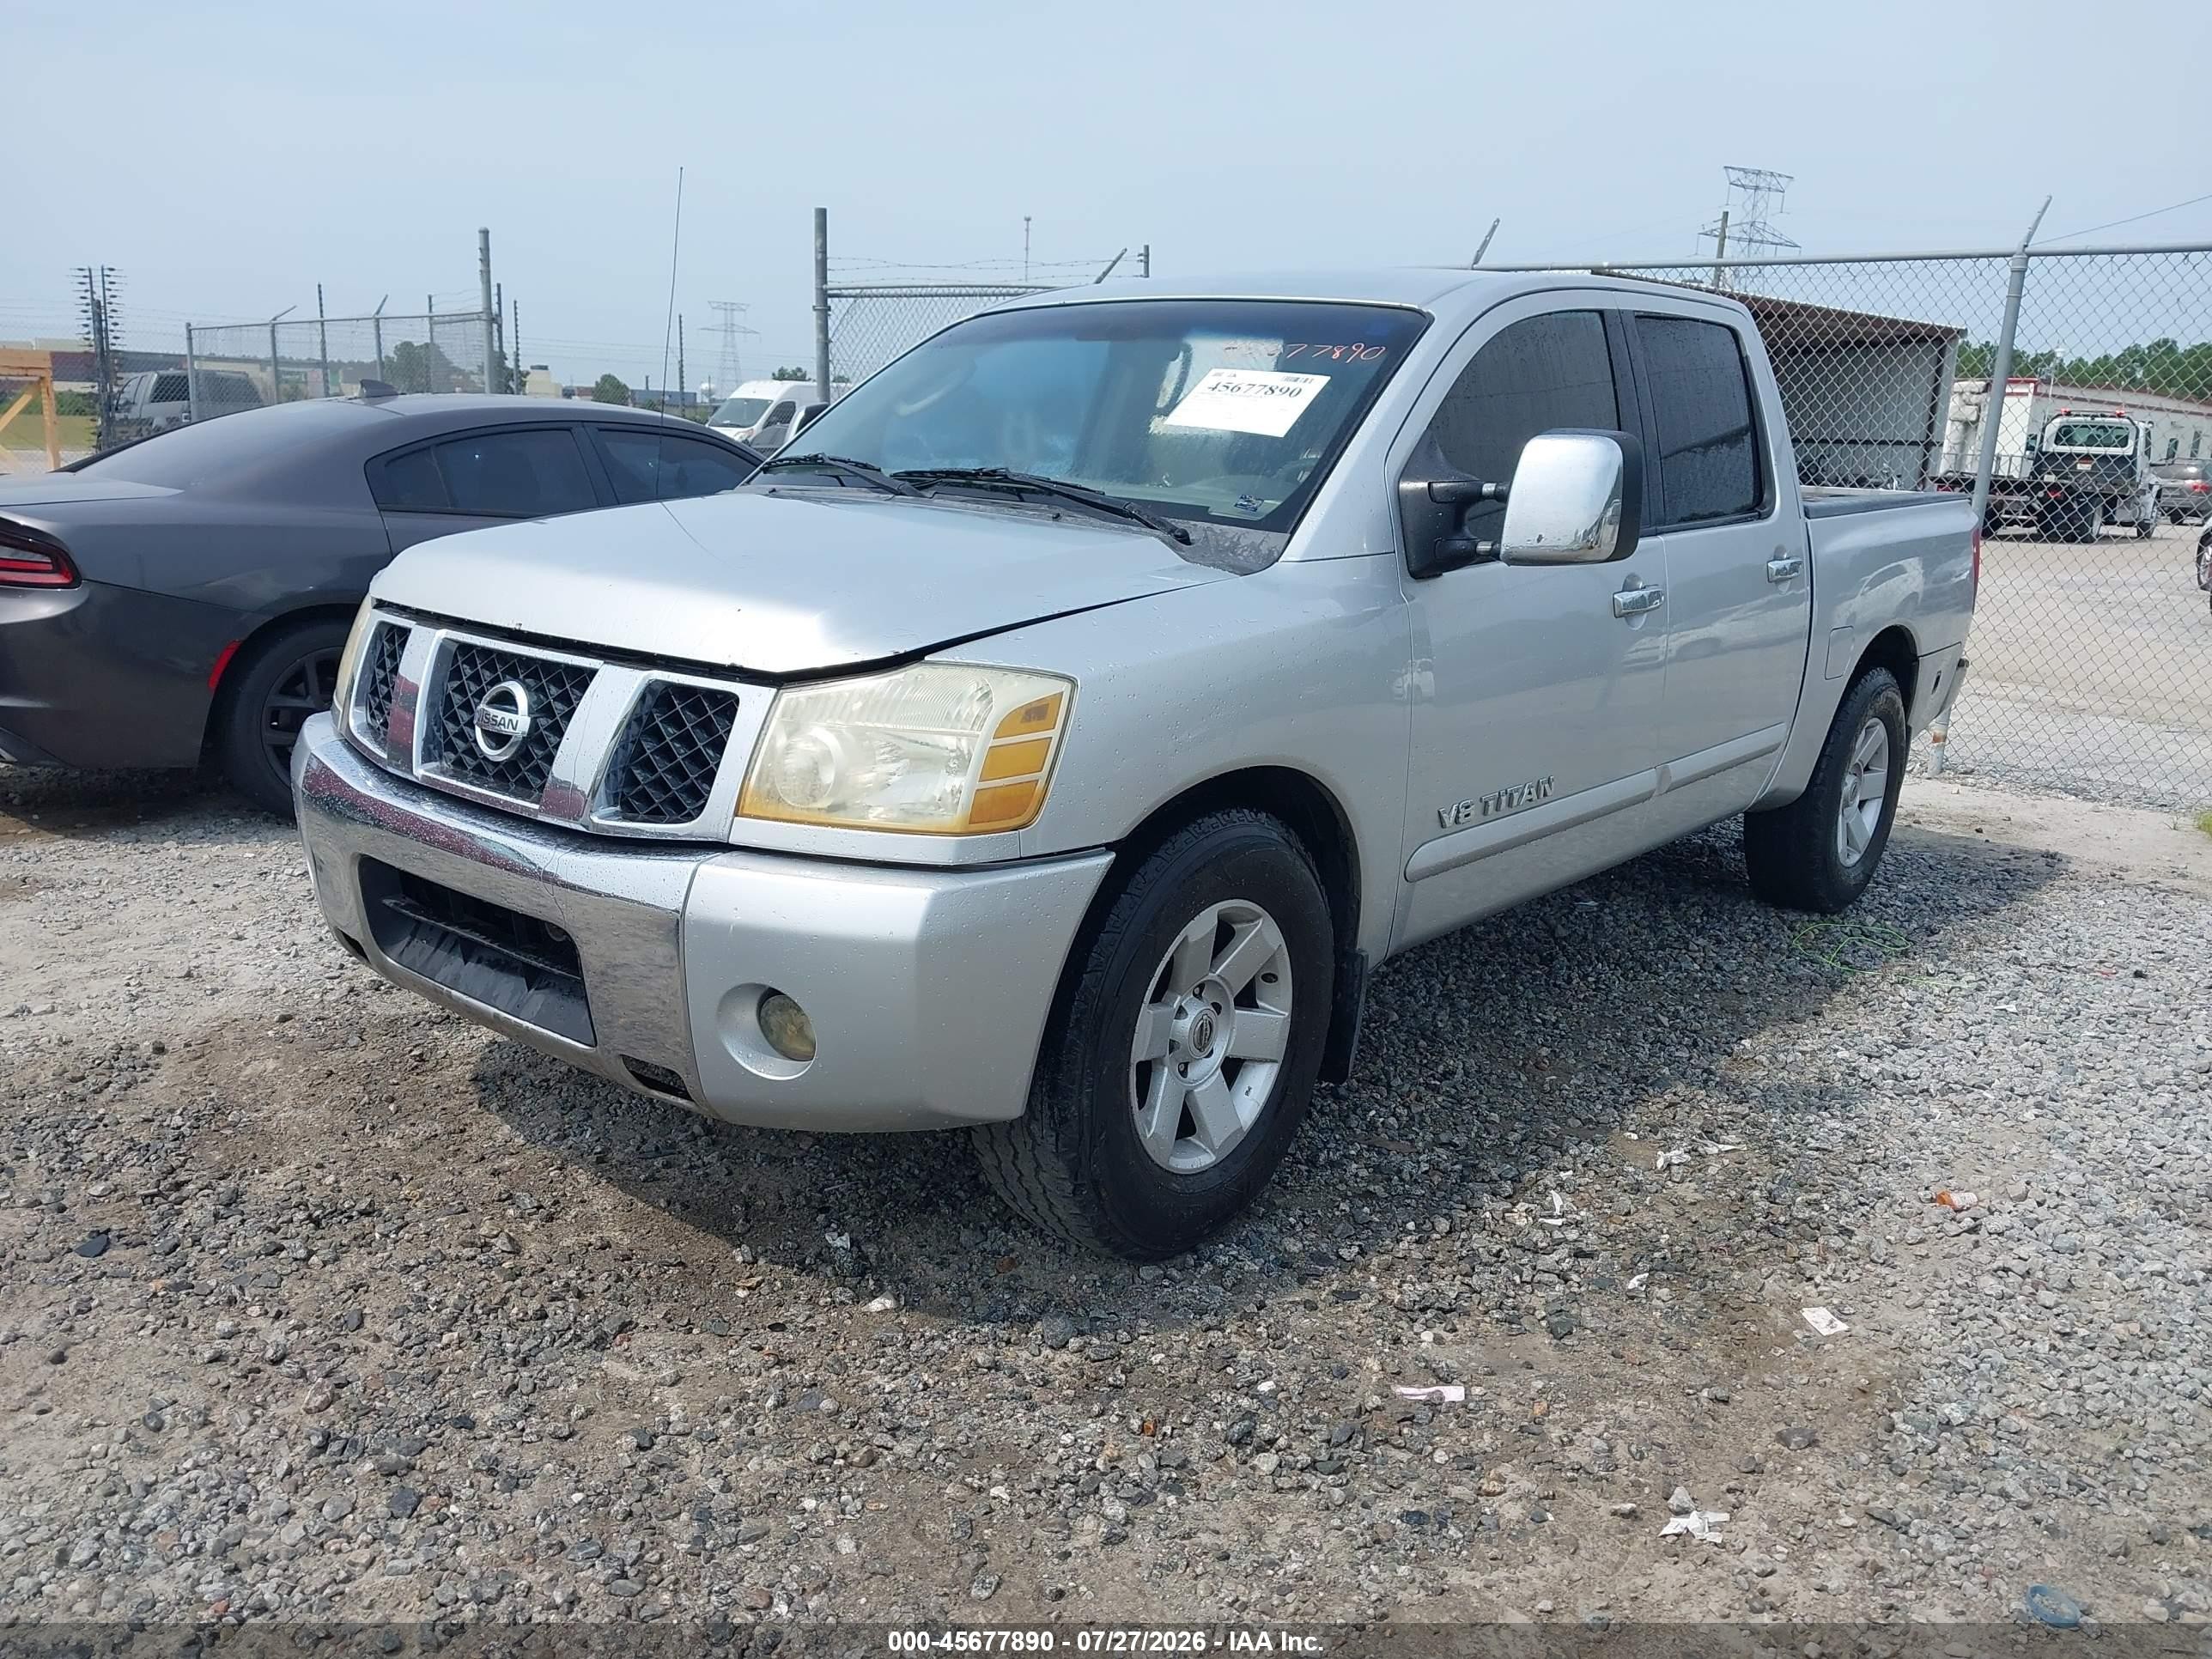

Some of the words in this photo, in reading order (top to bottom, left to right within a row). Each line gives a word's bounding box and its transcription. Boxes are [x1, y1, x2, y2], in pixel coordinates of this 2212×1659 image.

[1224, 343, 1386, 363] 77890
[1207, 381, 1303, 398] 45677890
[477, 707, 519, 732] NISSAN
[1480, 775, 1554, 816] TITAN
